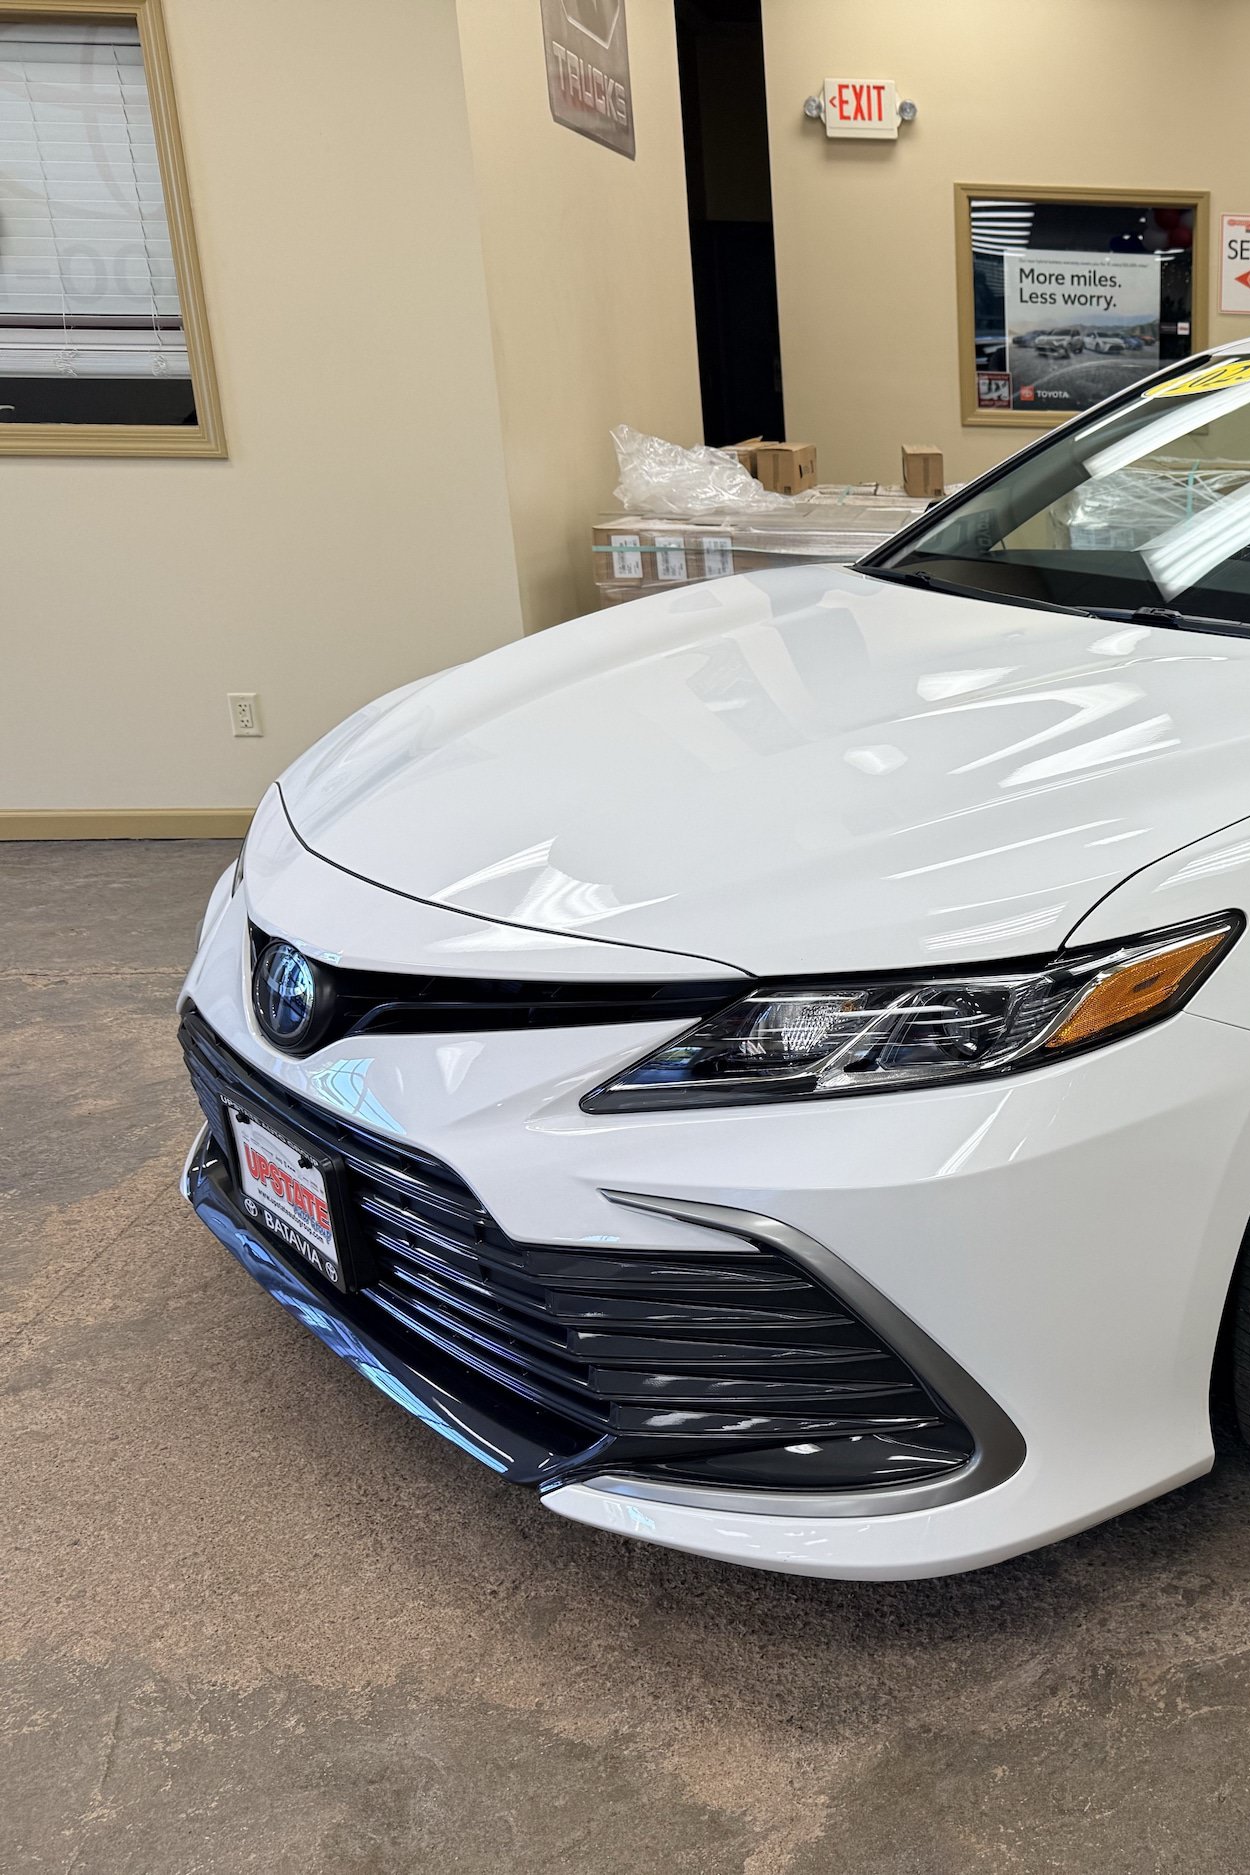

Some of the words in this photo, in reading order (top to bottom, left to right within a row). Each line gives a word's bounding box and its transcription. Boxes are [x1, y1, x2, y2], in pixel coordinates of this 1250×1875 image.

[552, 40, 627, 126] TRUCKS
[837, 84, 885, 122] EXIT
[1019, 267, 1066, 286] More
[1071, 269, 1122, 288] miles.
[1019, 287, 1057, 305] Less
[1062, 293, 1117, 311] worry.
[1037, 390, 1070, 399] TOYOTA
[243, 1141, 332, 1231] UPSTATE
[263, 1209, 323, 1272] BATAVIA
